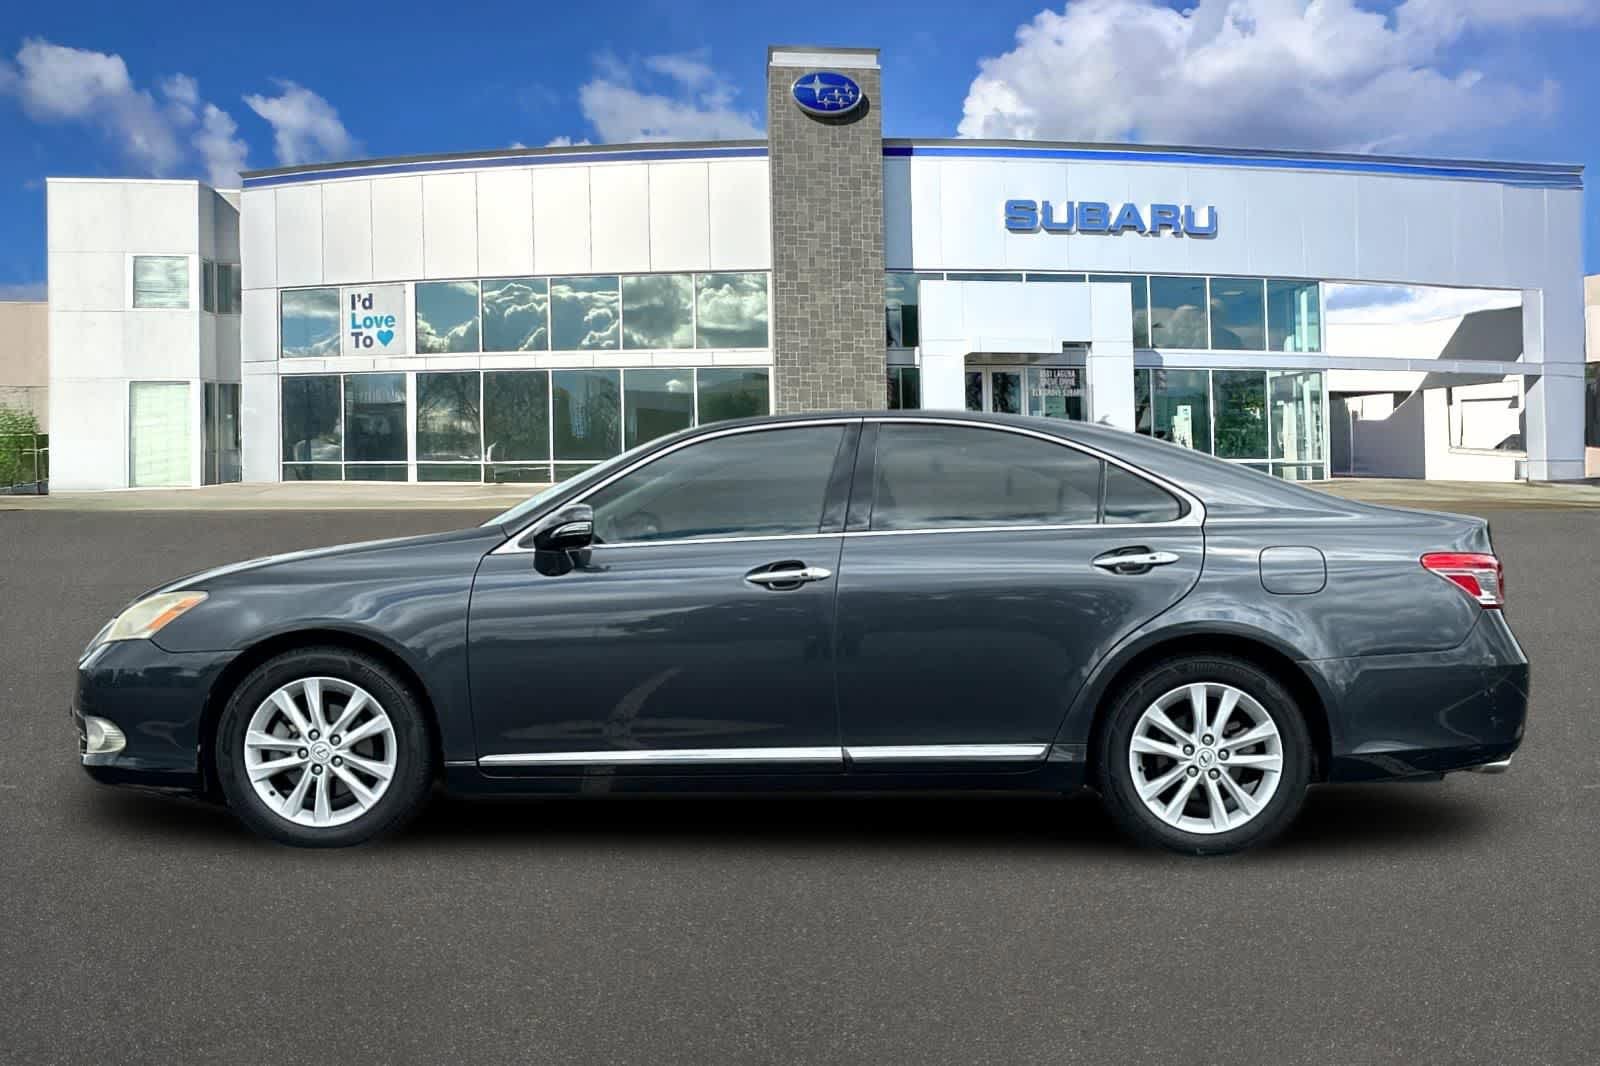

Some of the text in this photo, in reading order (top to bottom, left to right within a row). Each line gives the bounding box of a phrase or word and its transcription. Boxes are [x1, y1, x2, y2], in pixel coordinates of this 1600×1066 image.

[1005, 199, 1217, 239] SUBARU
[351, 292, 373, 310] I'd
[351, 312, 396, 329] Love
[351, 331, 374, 349] To
